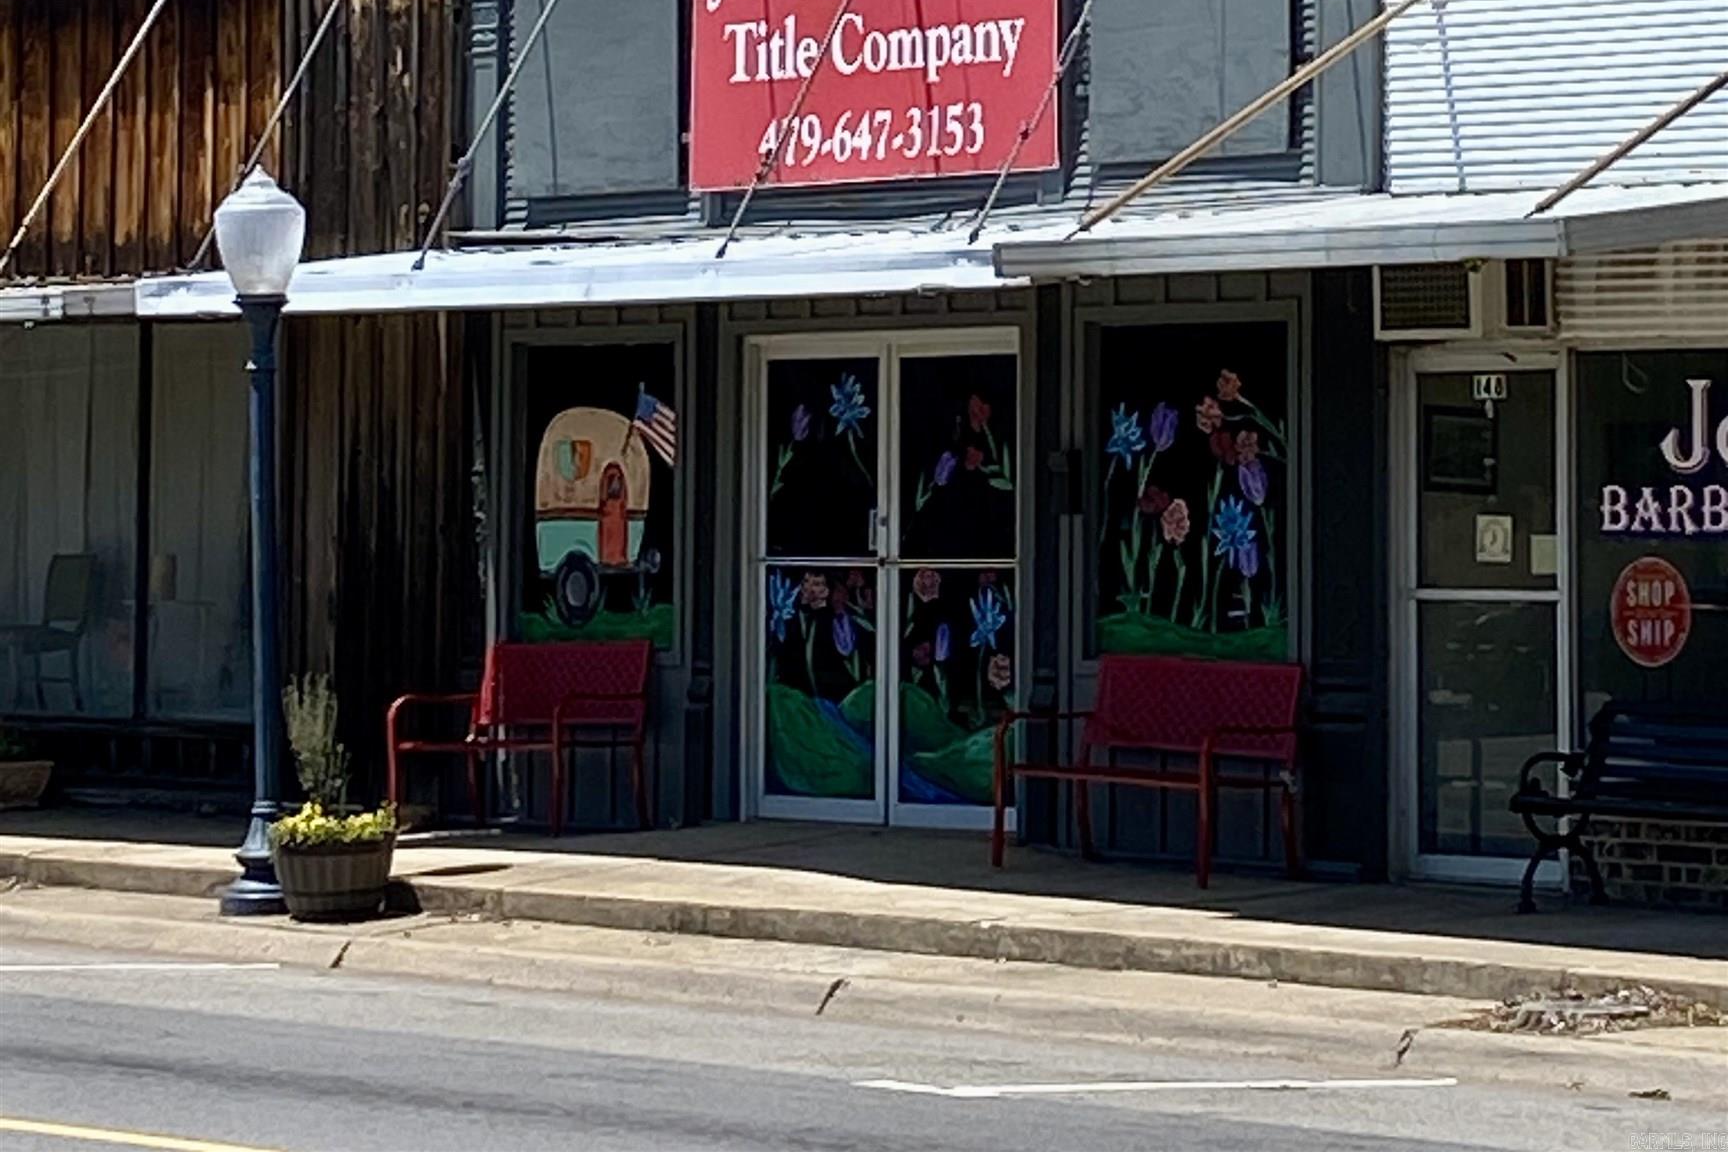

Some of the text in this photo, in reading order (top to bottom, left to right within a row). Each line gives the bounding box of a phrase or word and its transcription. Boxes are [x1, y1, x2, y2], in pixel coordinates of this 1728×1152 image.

[723, 12, 1024, 84] Title Company
[758, 101, 985, 167] 479-647-3153
[1600, 484, 1728, 535] BARB
[1626, 579, 1676, 608] SHOP
